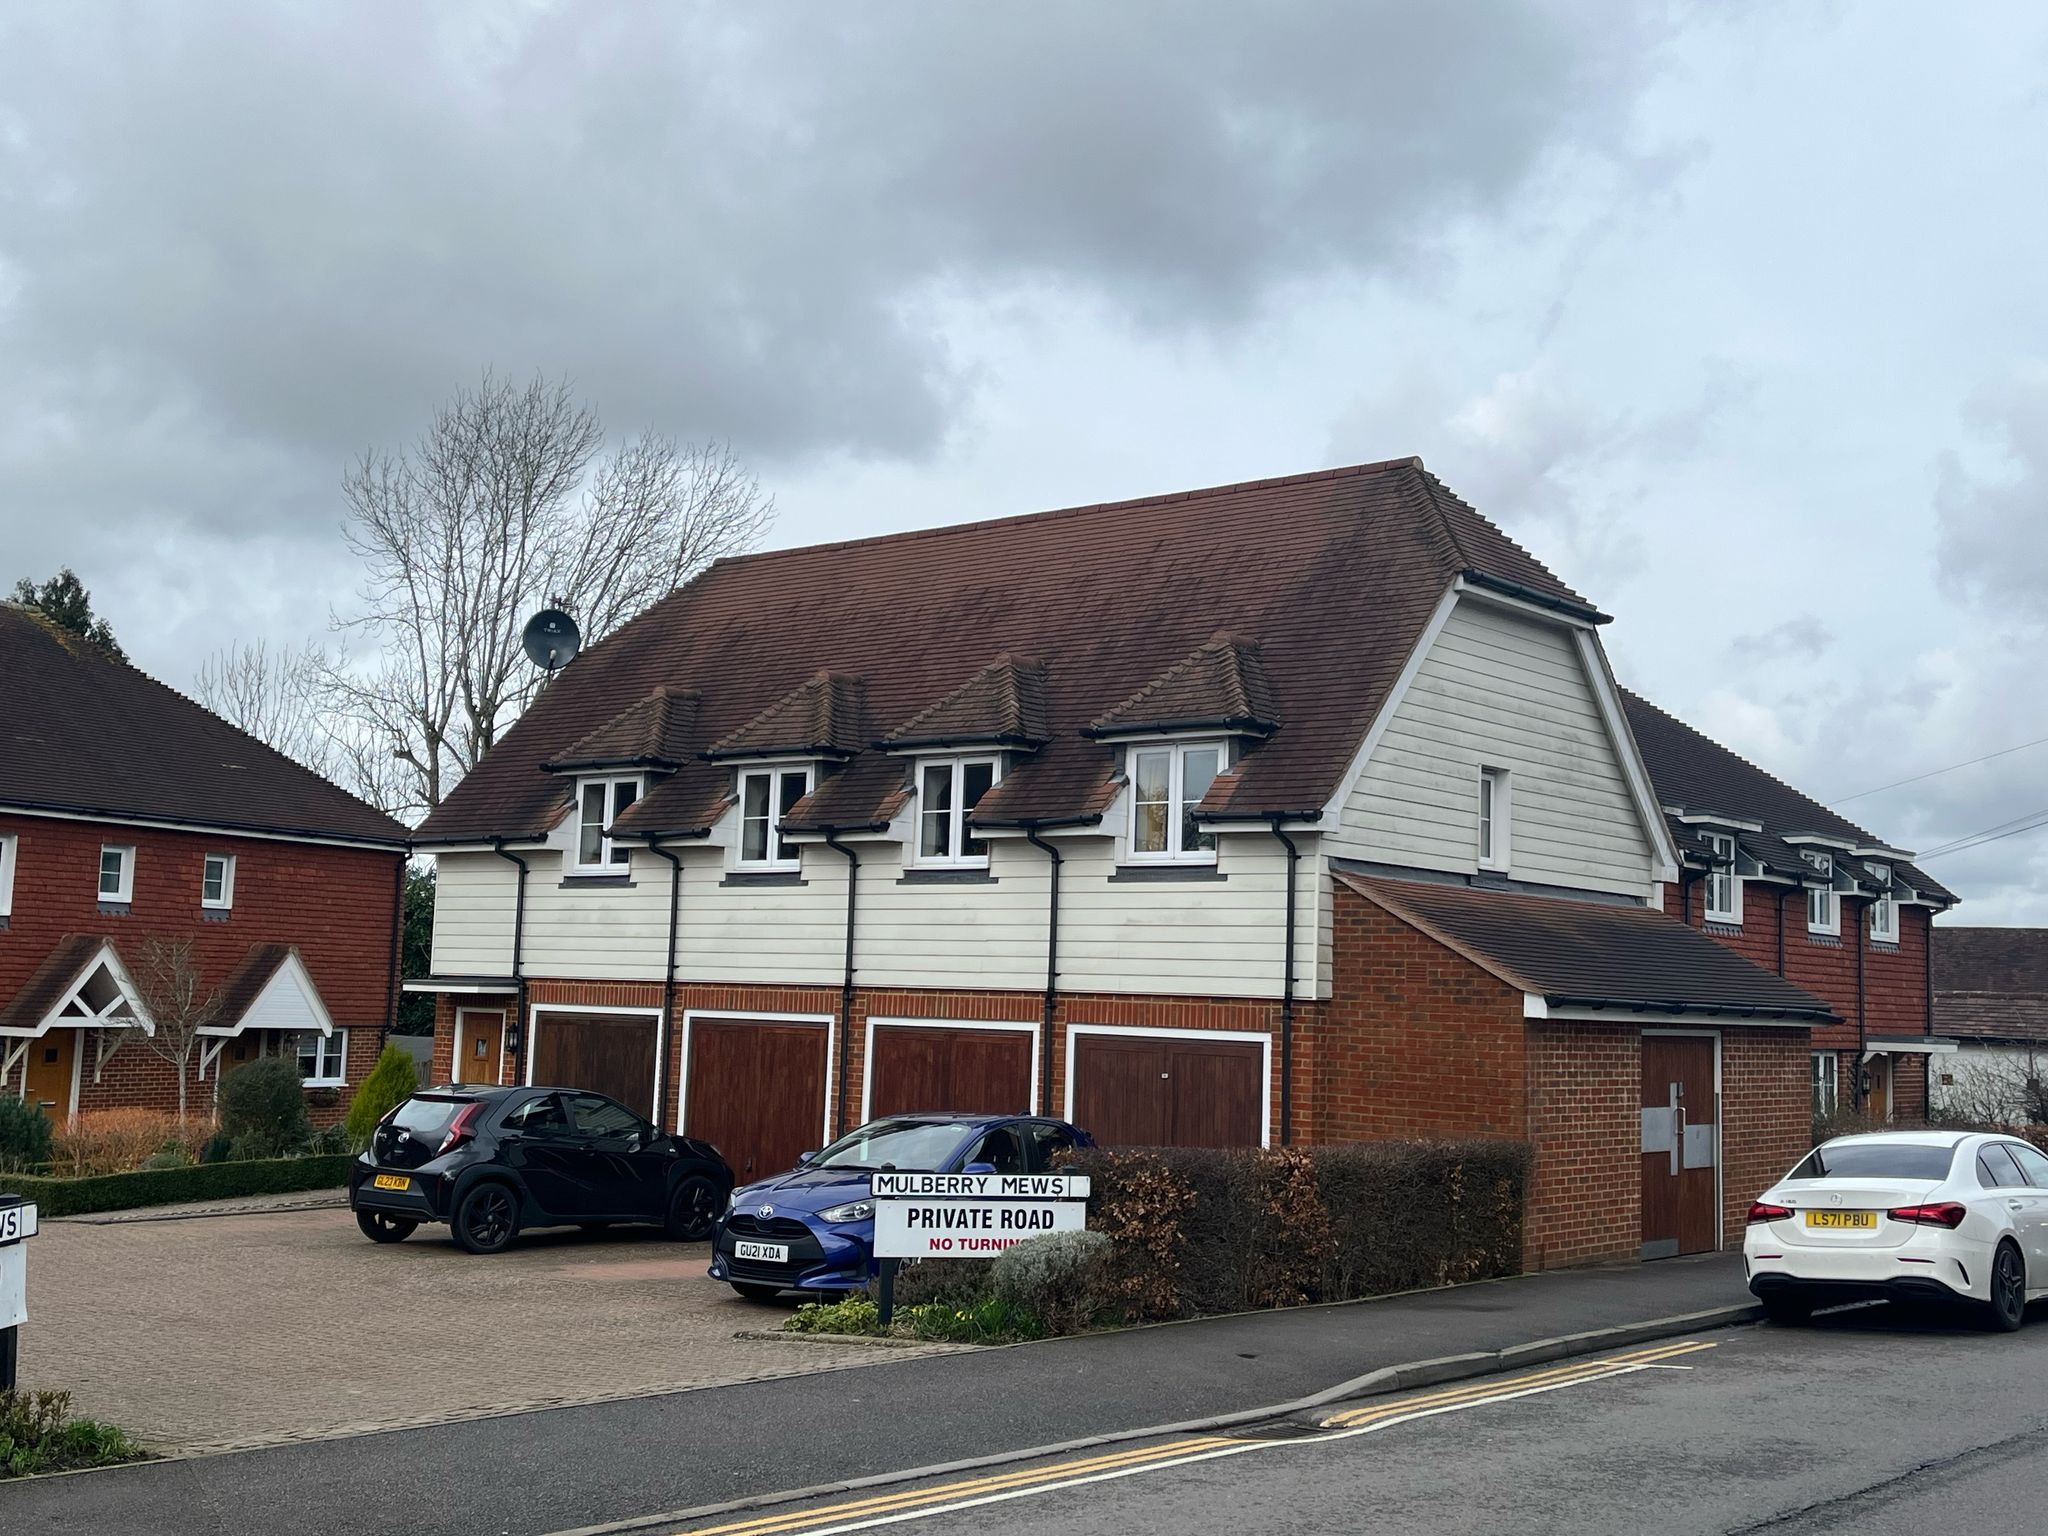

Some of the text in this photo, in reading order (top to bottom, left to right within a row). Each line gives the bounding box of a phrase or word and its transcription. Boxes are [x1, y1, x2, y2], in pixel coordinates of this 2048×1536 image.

[877, 1176, 1064, 1195] MULBERRY MEWS
[907, 1208, 1054, 1230] PRIVATE ROAD
[1813, 1213, 1869, 1226] LS71 PBU
[740, 1244, 781, 1260] GU21 XDA
[929, 1238, 953, 1250] NO
